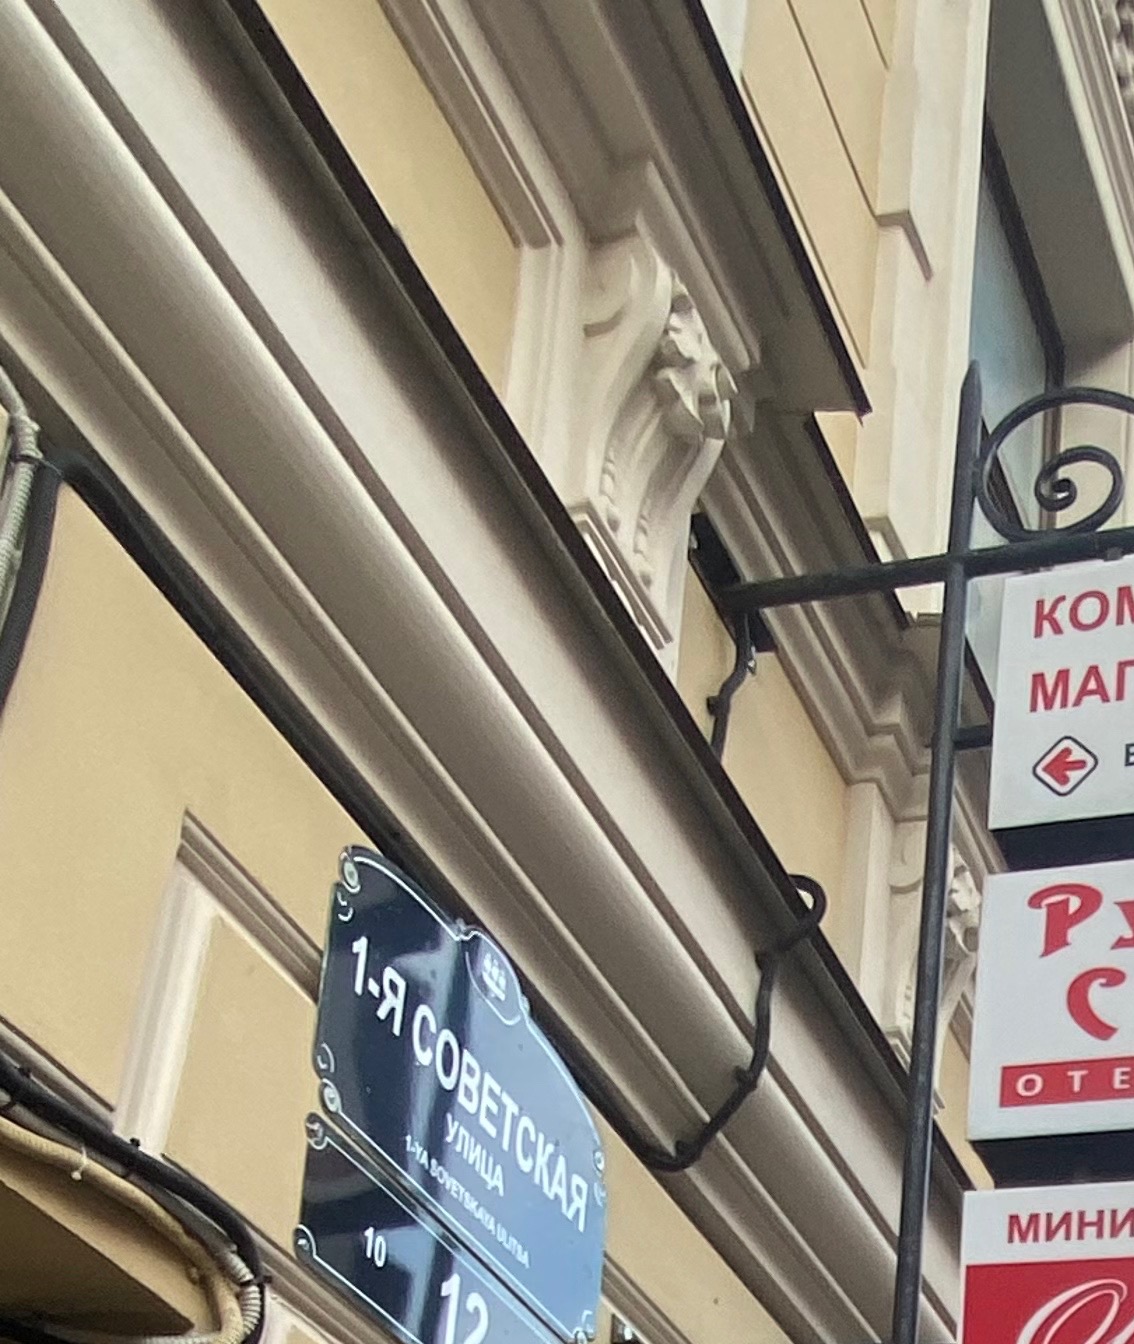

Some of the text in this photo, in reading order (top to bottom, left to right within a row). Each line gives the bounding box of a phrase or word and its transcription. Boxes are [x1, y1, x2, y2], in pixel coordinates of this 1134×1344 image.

[352, 936, 588, 1232] 1-Я СОВЕТСКАЯ
[406, 1134, 530, 1269] 1-YA SOVETSKAYA ULITSA
[446, 1112, 504, 1197] УЛИЦА
[364, 1226, 387, 1267] 10
